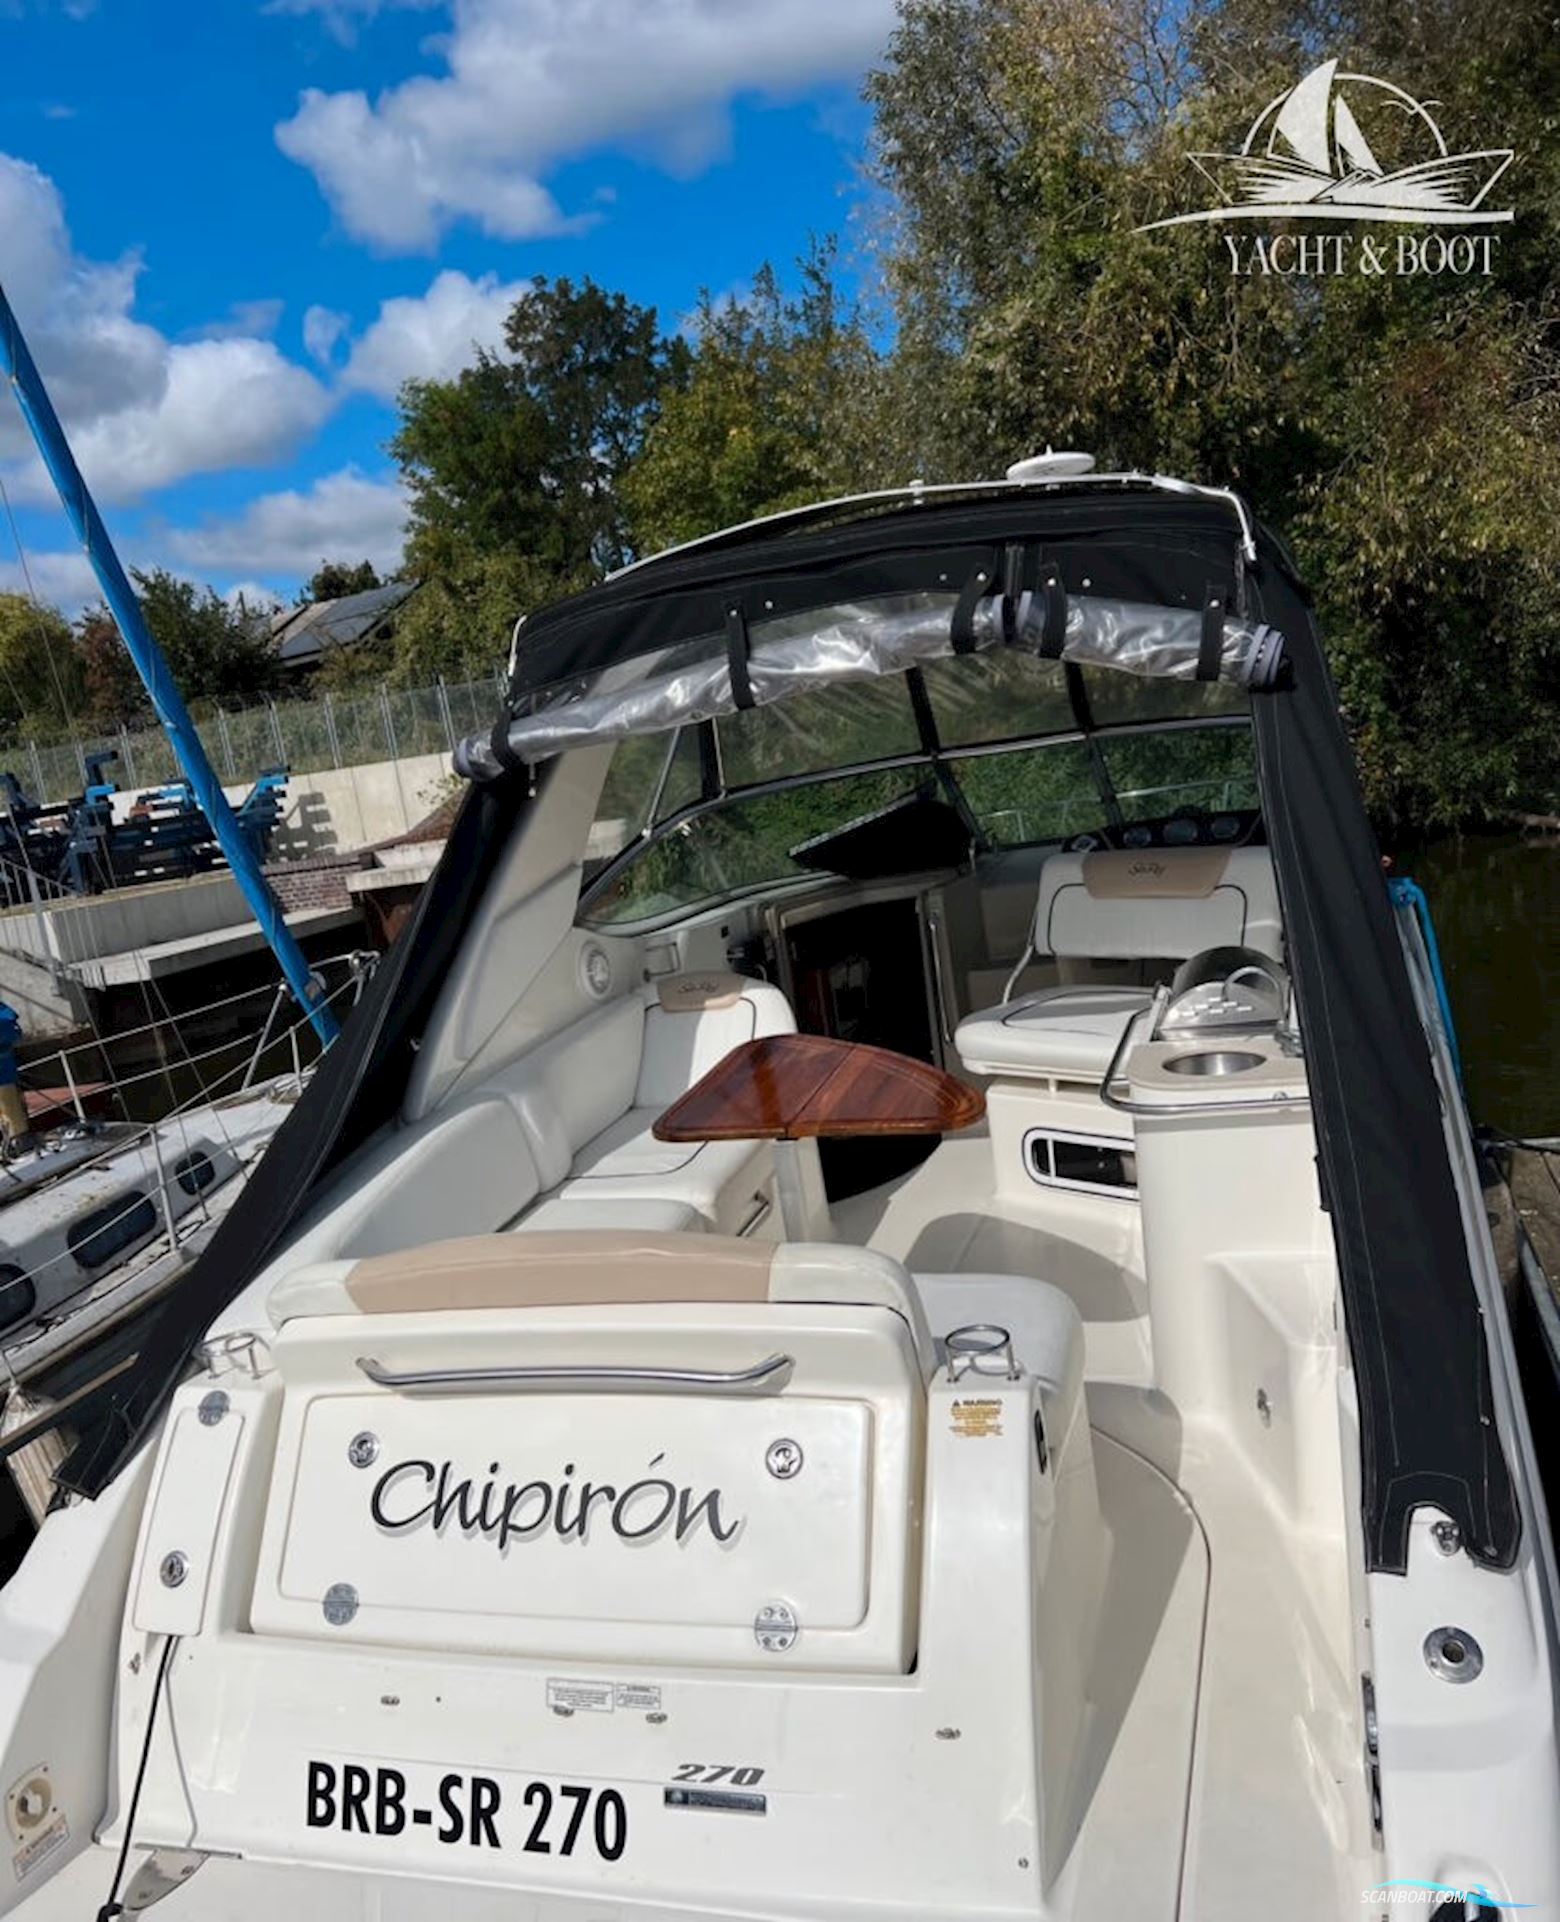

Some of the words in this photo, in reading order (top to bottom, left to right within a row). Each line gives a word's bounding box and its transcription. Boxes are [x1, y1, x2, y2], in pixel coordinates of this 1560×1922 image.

[371, 1452, 742, 1552] Chipirón
[306, 1761, 502, 1849] BRB-SR
[522, 1782, 627, 1861] 270
[671, 1764, 765, 1785] 270
